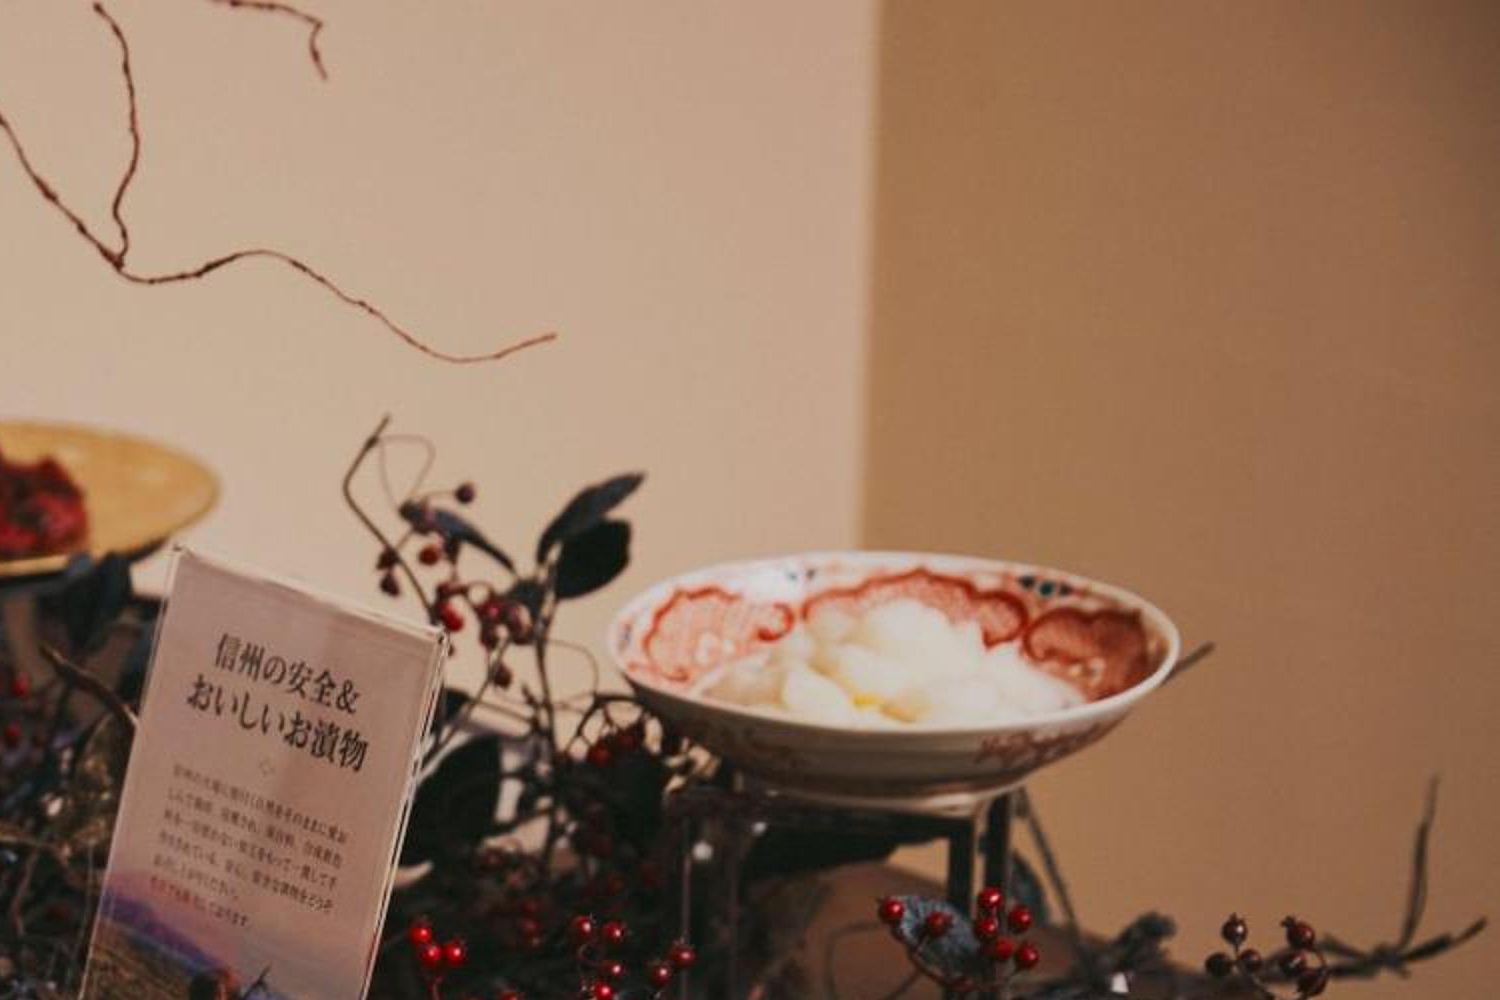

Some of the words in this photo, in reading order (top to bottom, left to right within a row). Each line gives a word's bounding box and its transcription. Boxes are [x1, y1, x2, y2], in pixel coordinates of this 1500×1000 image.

[215, 633, 360, 714] 信州の安全&
[186, 674, 369, 772] おいしいお漬物
